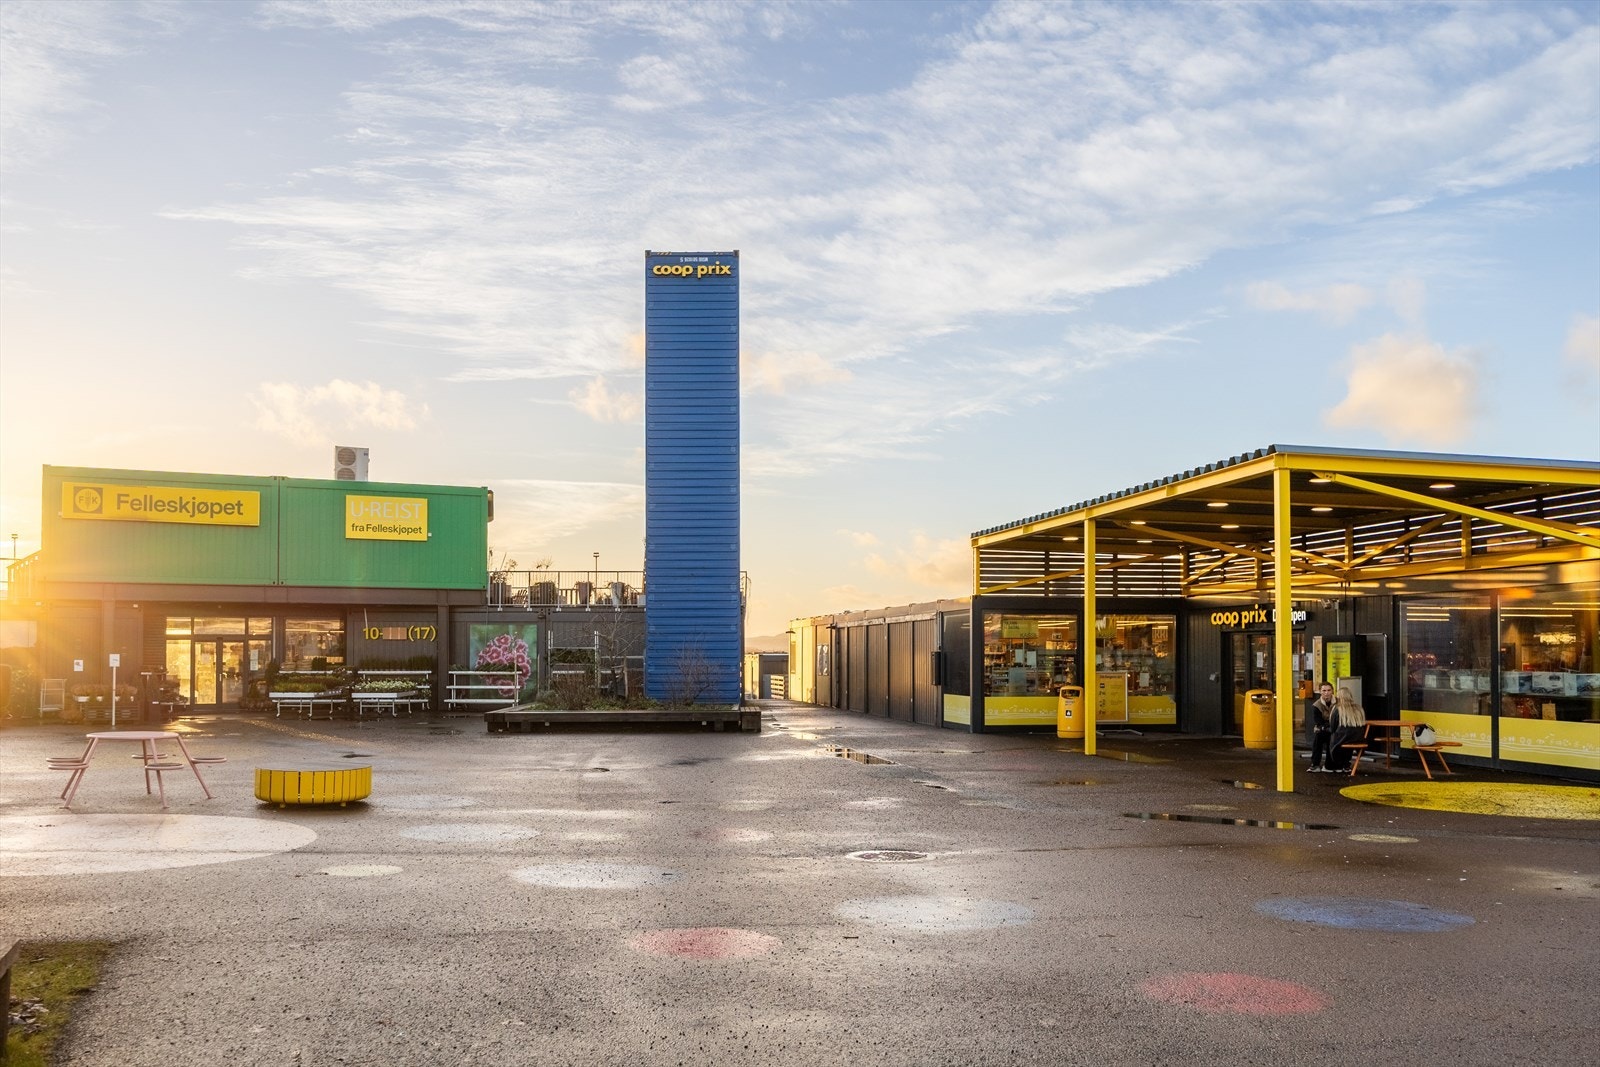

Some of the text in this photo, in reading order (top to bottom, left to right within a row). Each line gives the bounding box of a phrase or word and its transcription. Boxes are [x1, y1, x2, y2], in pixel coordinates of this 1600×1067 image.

[653, 261, 731, 278] coop prix
[116, 494, 244, 518] Felleskjøpet
[351, 523, 422, 536] fra Felleskjøpet
[1211, 611, 1239, 627] coop
[1241, 604, 1267, 629] prix
[408, 625, 436, 642] (17)
